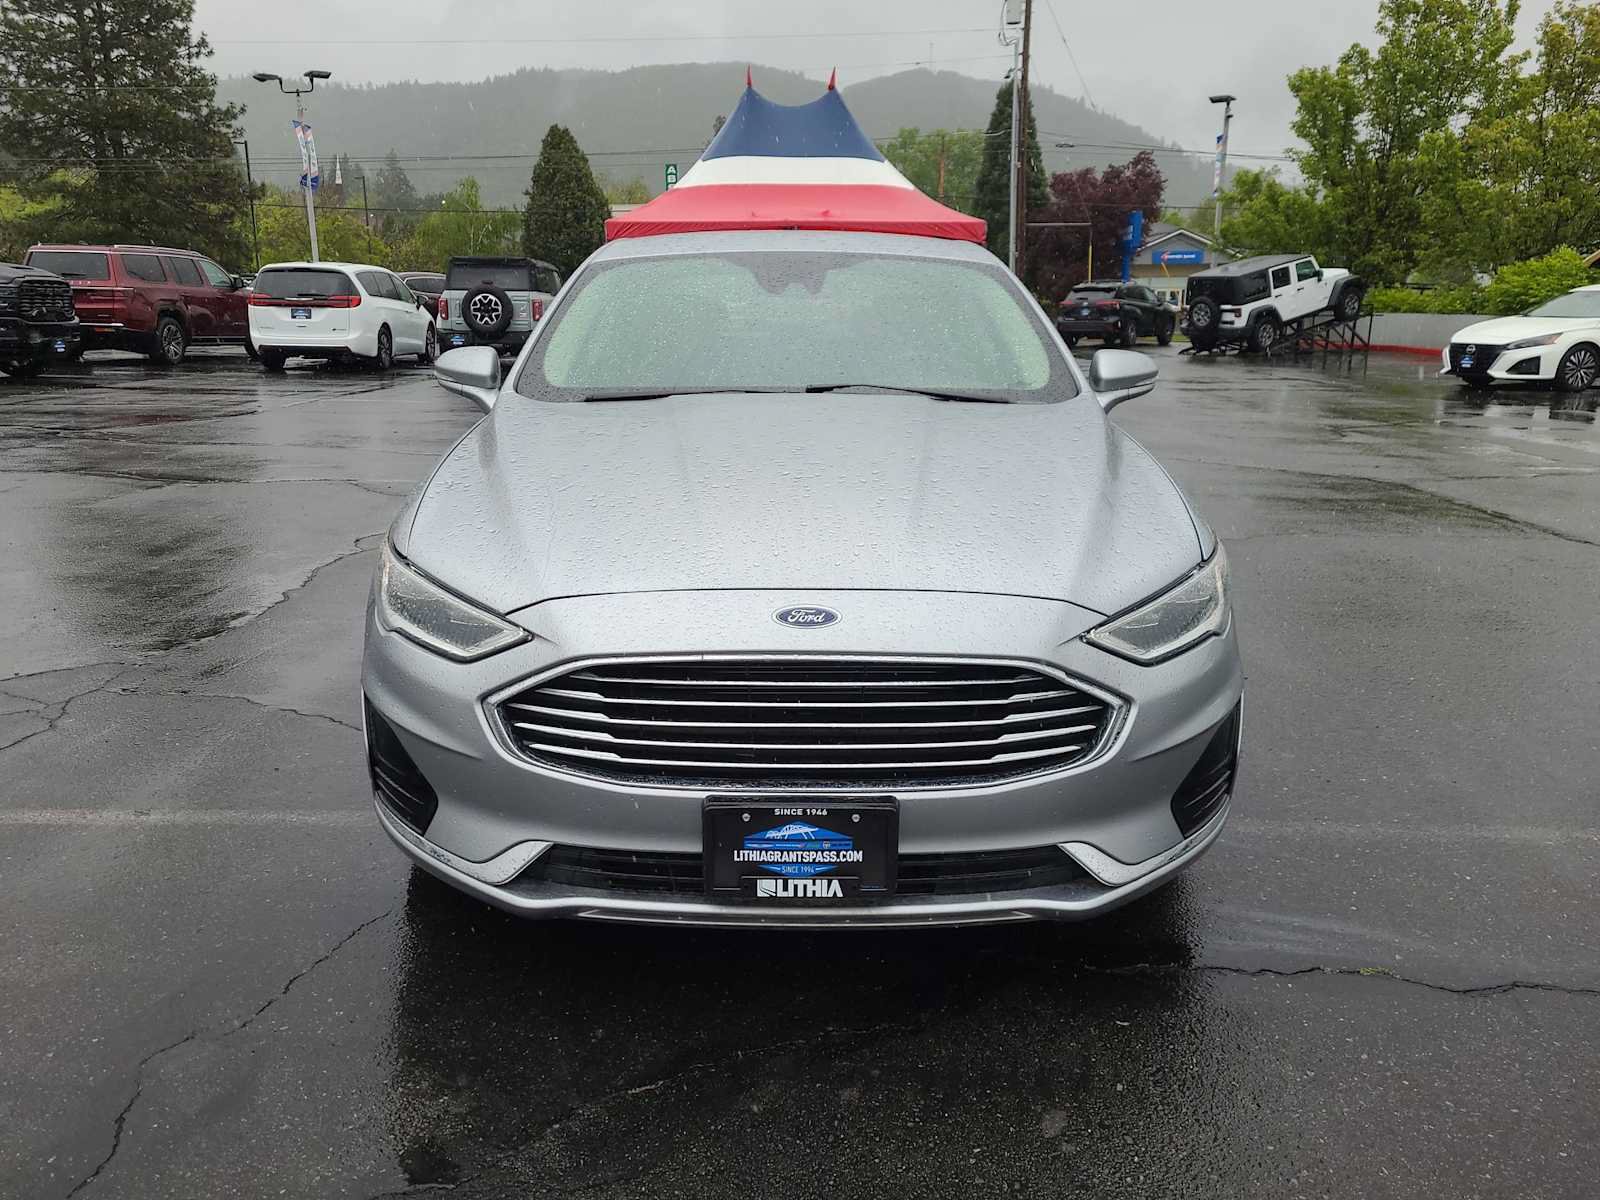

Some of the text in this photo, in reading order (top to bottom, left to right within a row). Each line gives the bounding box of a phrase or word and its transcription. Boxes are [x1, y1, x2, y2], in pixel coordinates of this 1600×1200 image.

[787, 609, 826, 623] Ford
[774, 808, 828, 816] SINCE 1946
[733, 850, 864, 863] LITHIAGRANTSPASS.COM
[782, 865, 800, 874] SINCE
[776, 879, 844, 898] LITHIA
